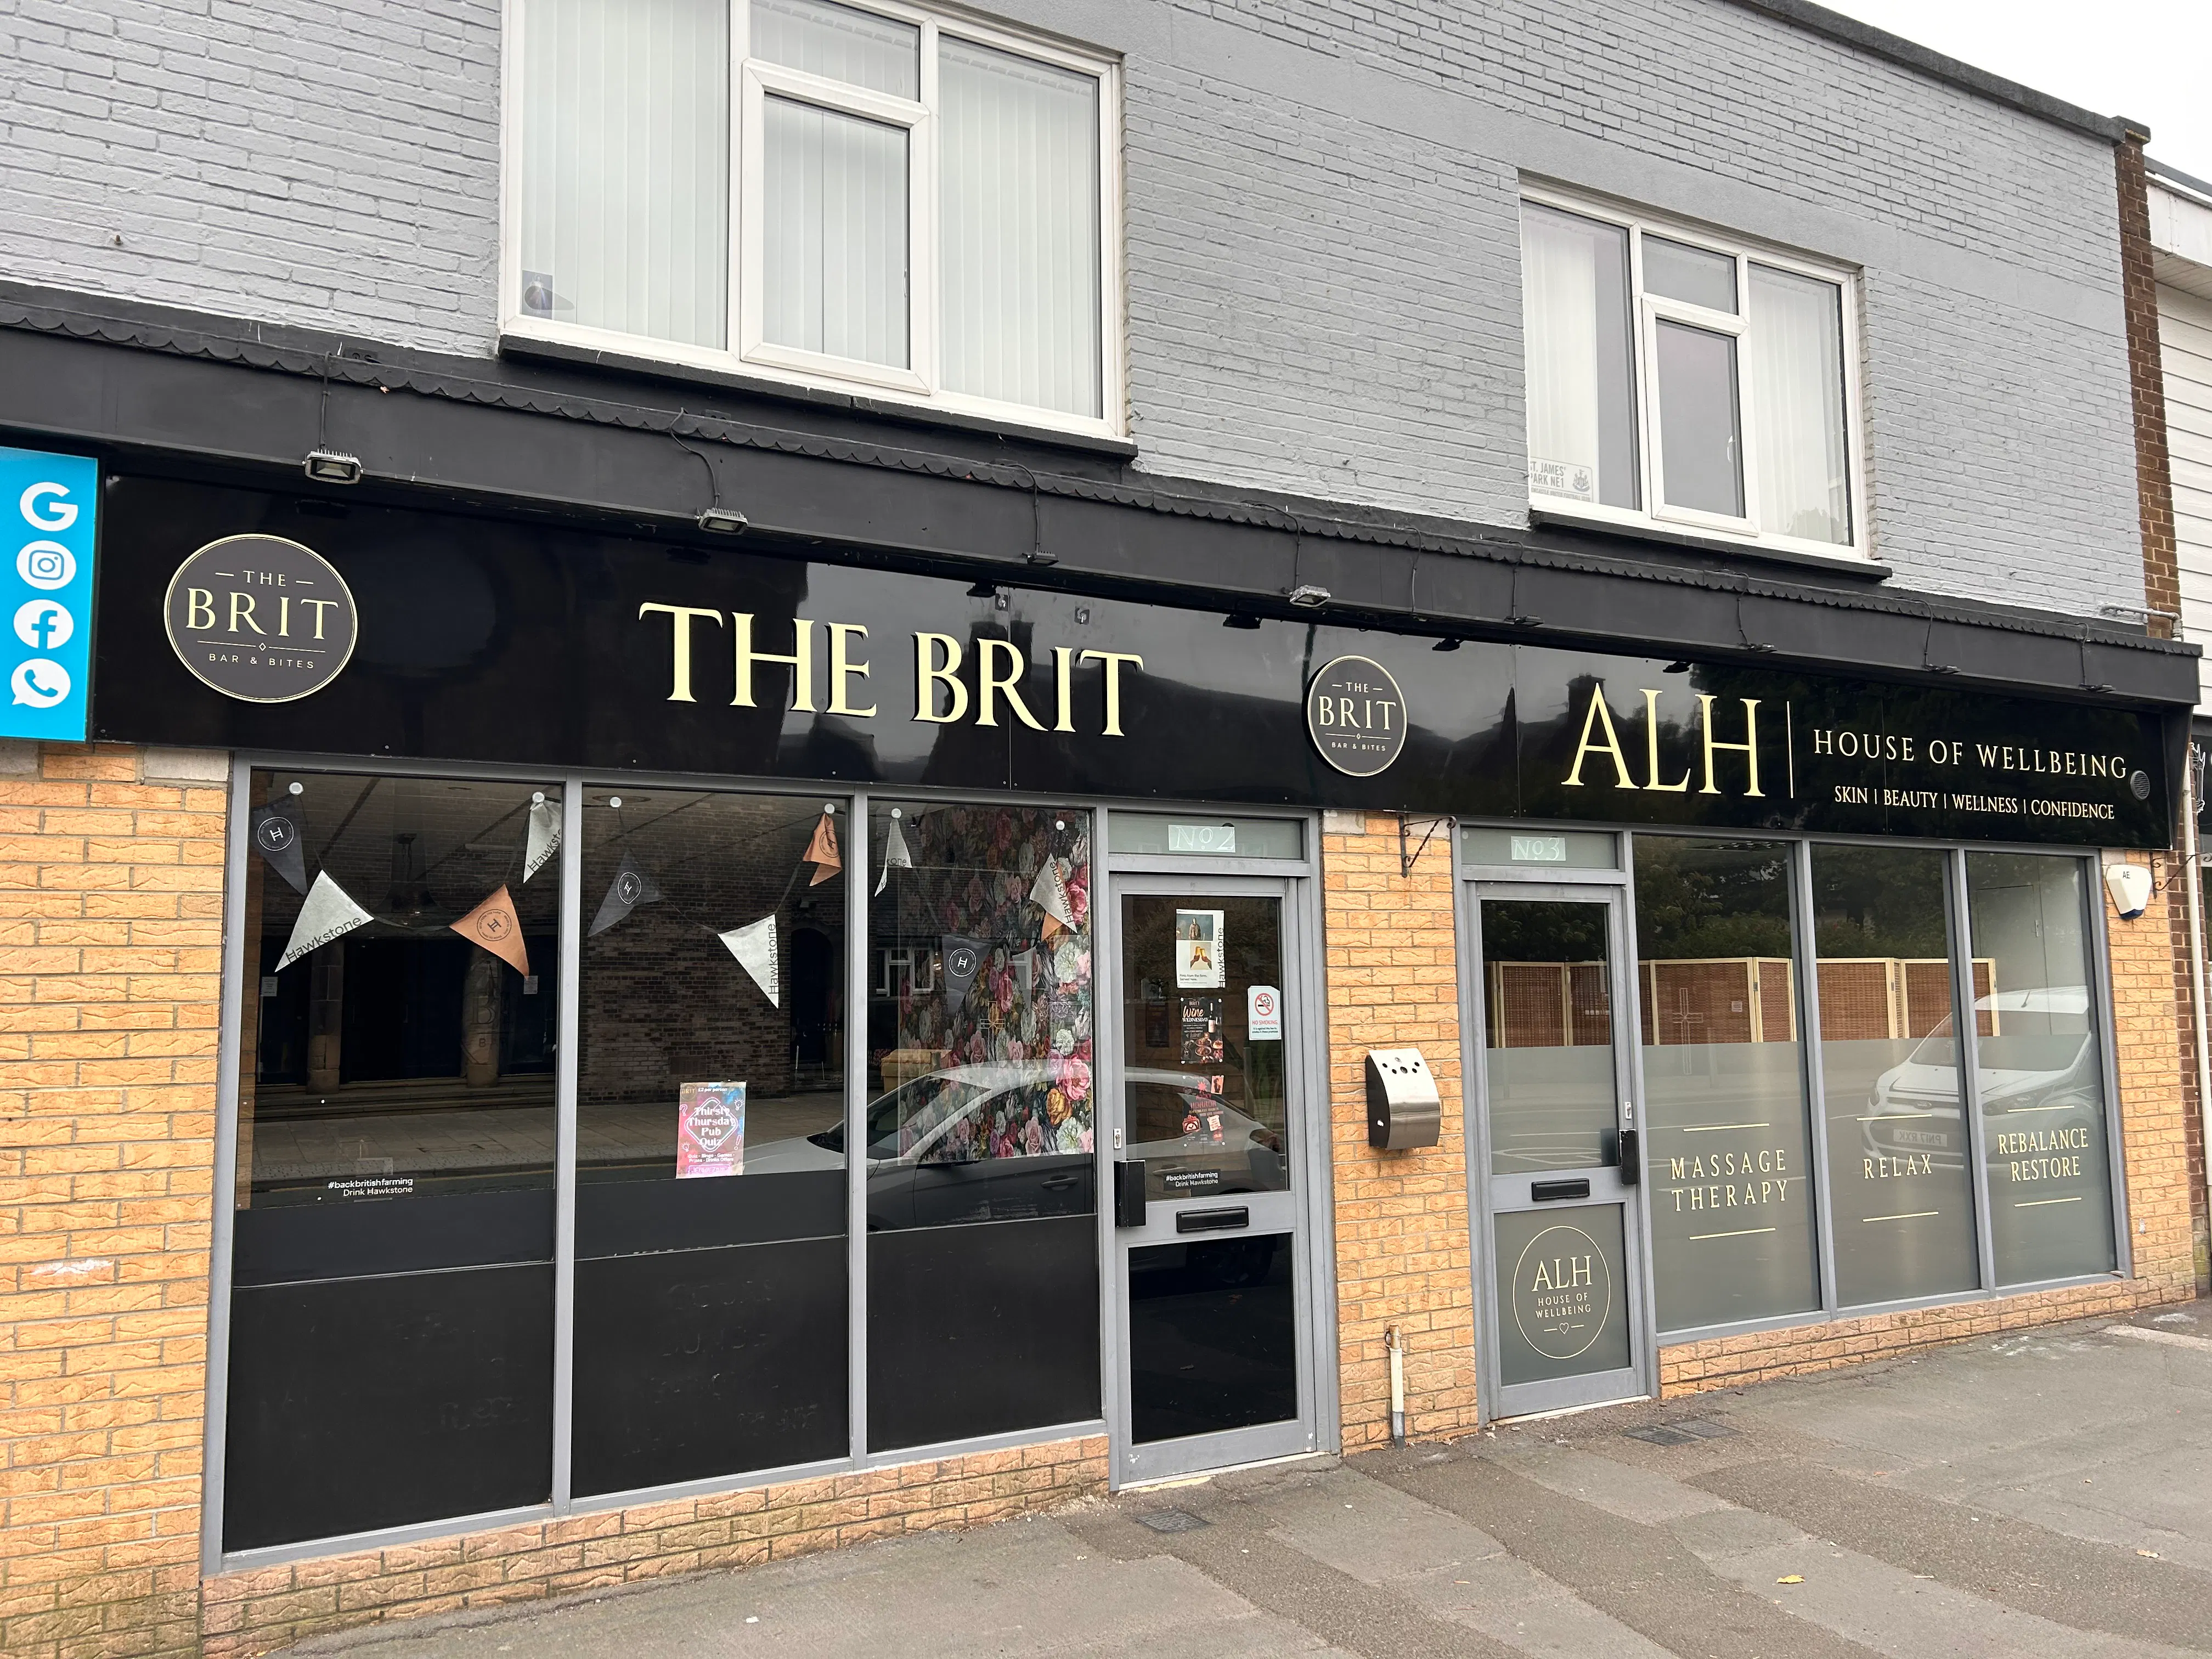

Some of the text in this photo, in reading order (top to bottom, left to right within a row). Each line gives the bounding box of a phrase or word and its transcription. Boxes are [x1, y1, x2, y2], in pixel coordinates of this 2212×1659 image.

[1550, 476, 1564, 488] NE1
[243, 571, 286, 586] THE
[185, 588, 338, 639] BRIT
[209, 653, 315, 669] BAR & BITES
[639, 602, 1144, 737] THE BRIT
[1346, 682, 1369, 693] THE
[1319, 696, 1396, 730] BRIT
[1561, 682, 1765, 797] ALH
[1814, 729, 2128, 779] HOUSE OF WELLBEING
[1835, 786, 1867, 804] SKIN
[1883, 789, 1938, 809] BEAUTY
[1952, 794, 2018, 814] WELLNESS
[2031, 799, 2115, 820] CONFIDENCE
[1050, 862, 1074, 924] Hawkstone
[285, 917, 362, 963] Hawkstone
[768, 924, 778, 994] Hawkstone
[1217, 927, 1226, 988] Hawkstone
[1183, 1006, 1204, 1018] Wine
[689, 1117, 736, 1126] Thursday
[694, 1107, 730, 1116] Thirsty
[699, 1138, 722, 1147] Quiz
[701, 1127, 721, 1136] Pub
[1997, 1128, 2089, 1155] REBALANCE
[1166, 1171, 1218, 1181] #backbritishfarming
[1671, 1149, 1786, 1180] MASSAGE
[1864, 1154, 1932, 1179] RELAX
[2010, 1156, 2081, 1182] RESTORE
[328, 1178, 413, 1189] #backbritishfarming
[343, 1186, 413, 1197] Drink Hawkstone
[1672, 1180, 1787, 1211] THERAPY
[1532, 1255, 1592, 1291] ALH
[1536, 1304, 1591, 1318] WELLBEING
[1538, 1293, 1588, 1306] HOUSE OF
